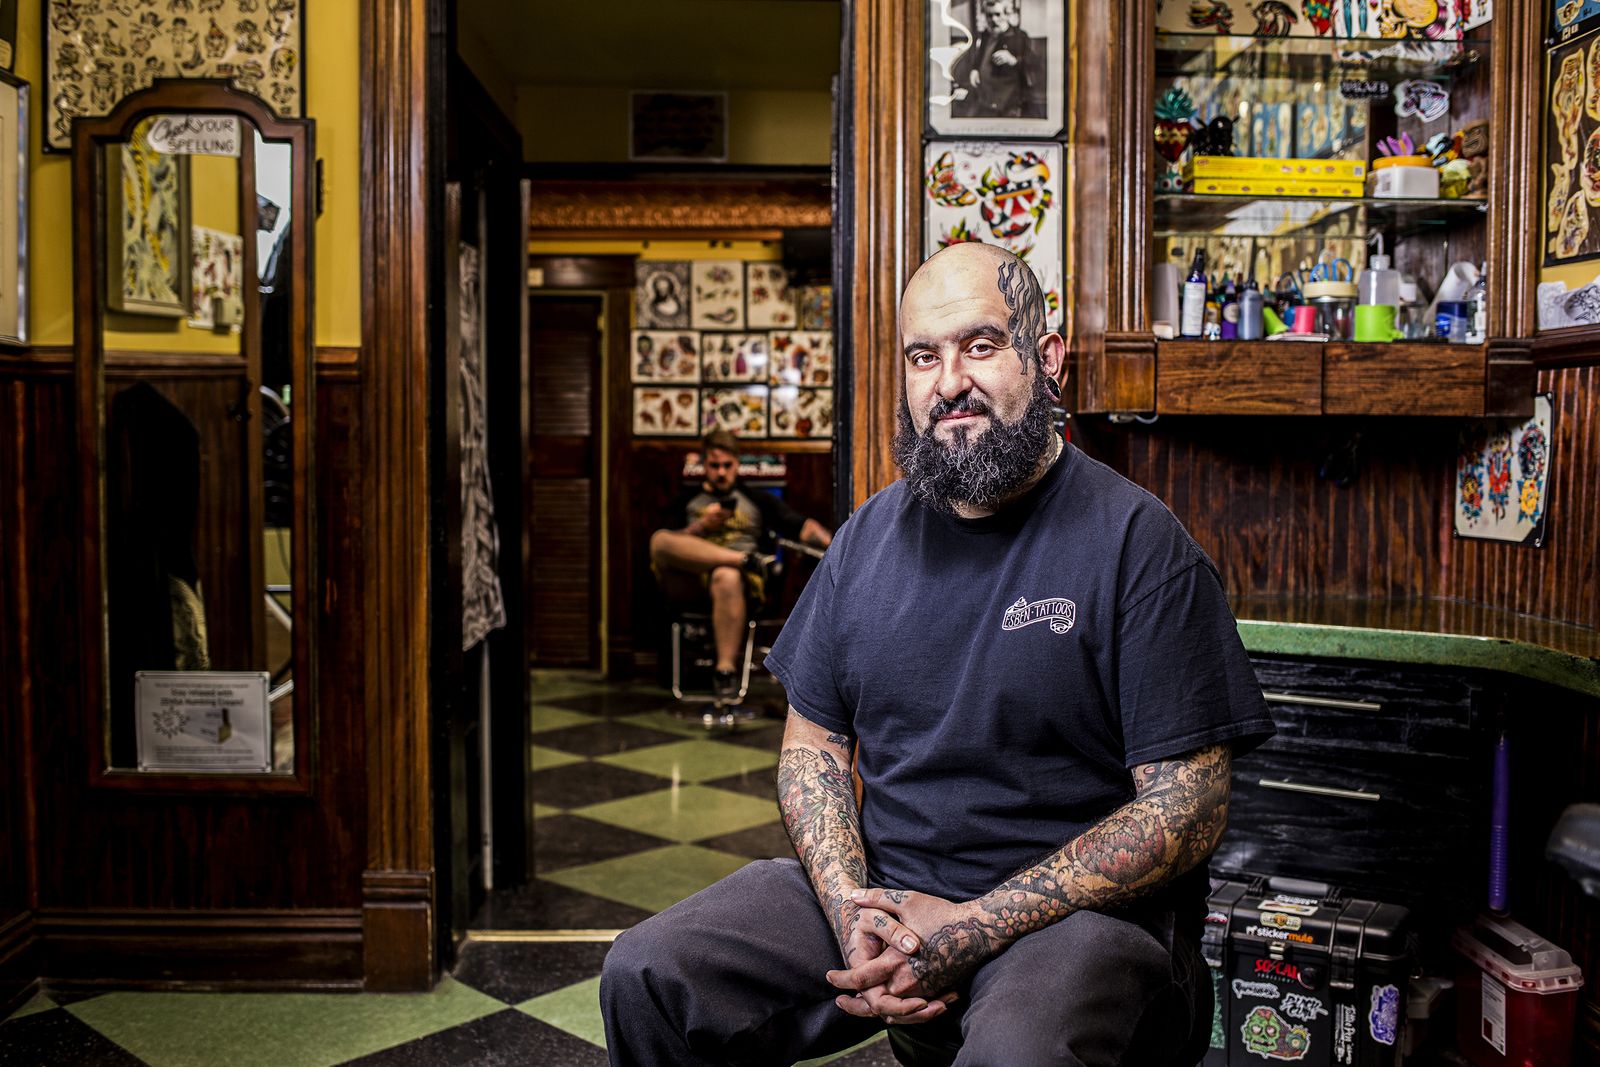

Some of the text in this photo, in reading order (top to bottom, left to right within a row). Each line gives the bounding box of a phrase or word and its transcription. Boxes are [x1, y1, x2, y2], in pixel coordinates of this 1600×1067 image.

[153, 114, 234, 142] Check YOUR
[168, 139, 234, 153] SPELLING
[1004, 602, 1073, 628] ESBEN TATTOOS
